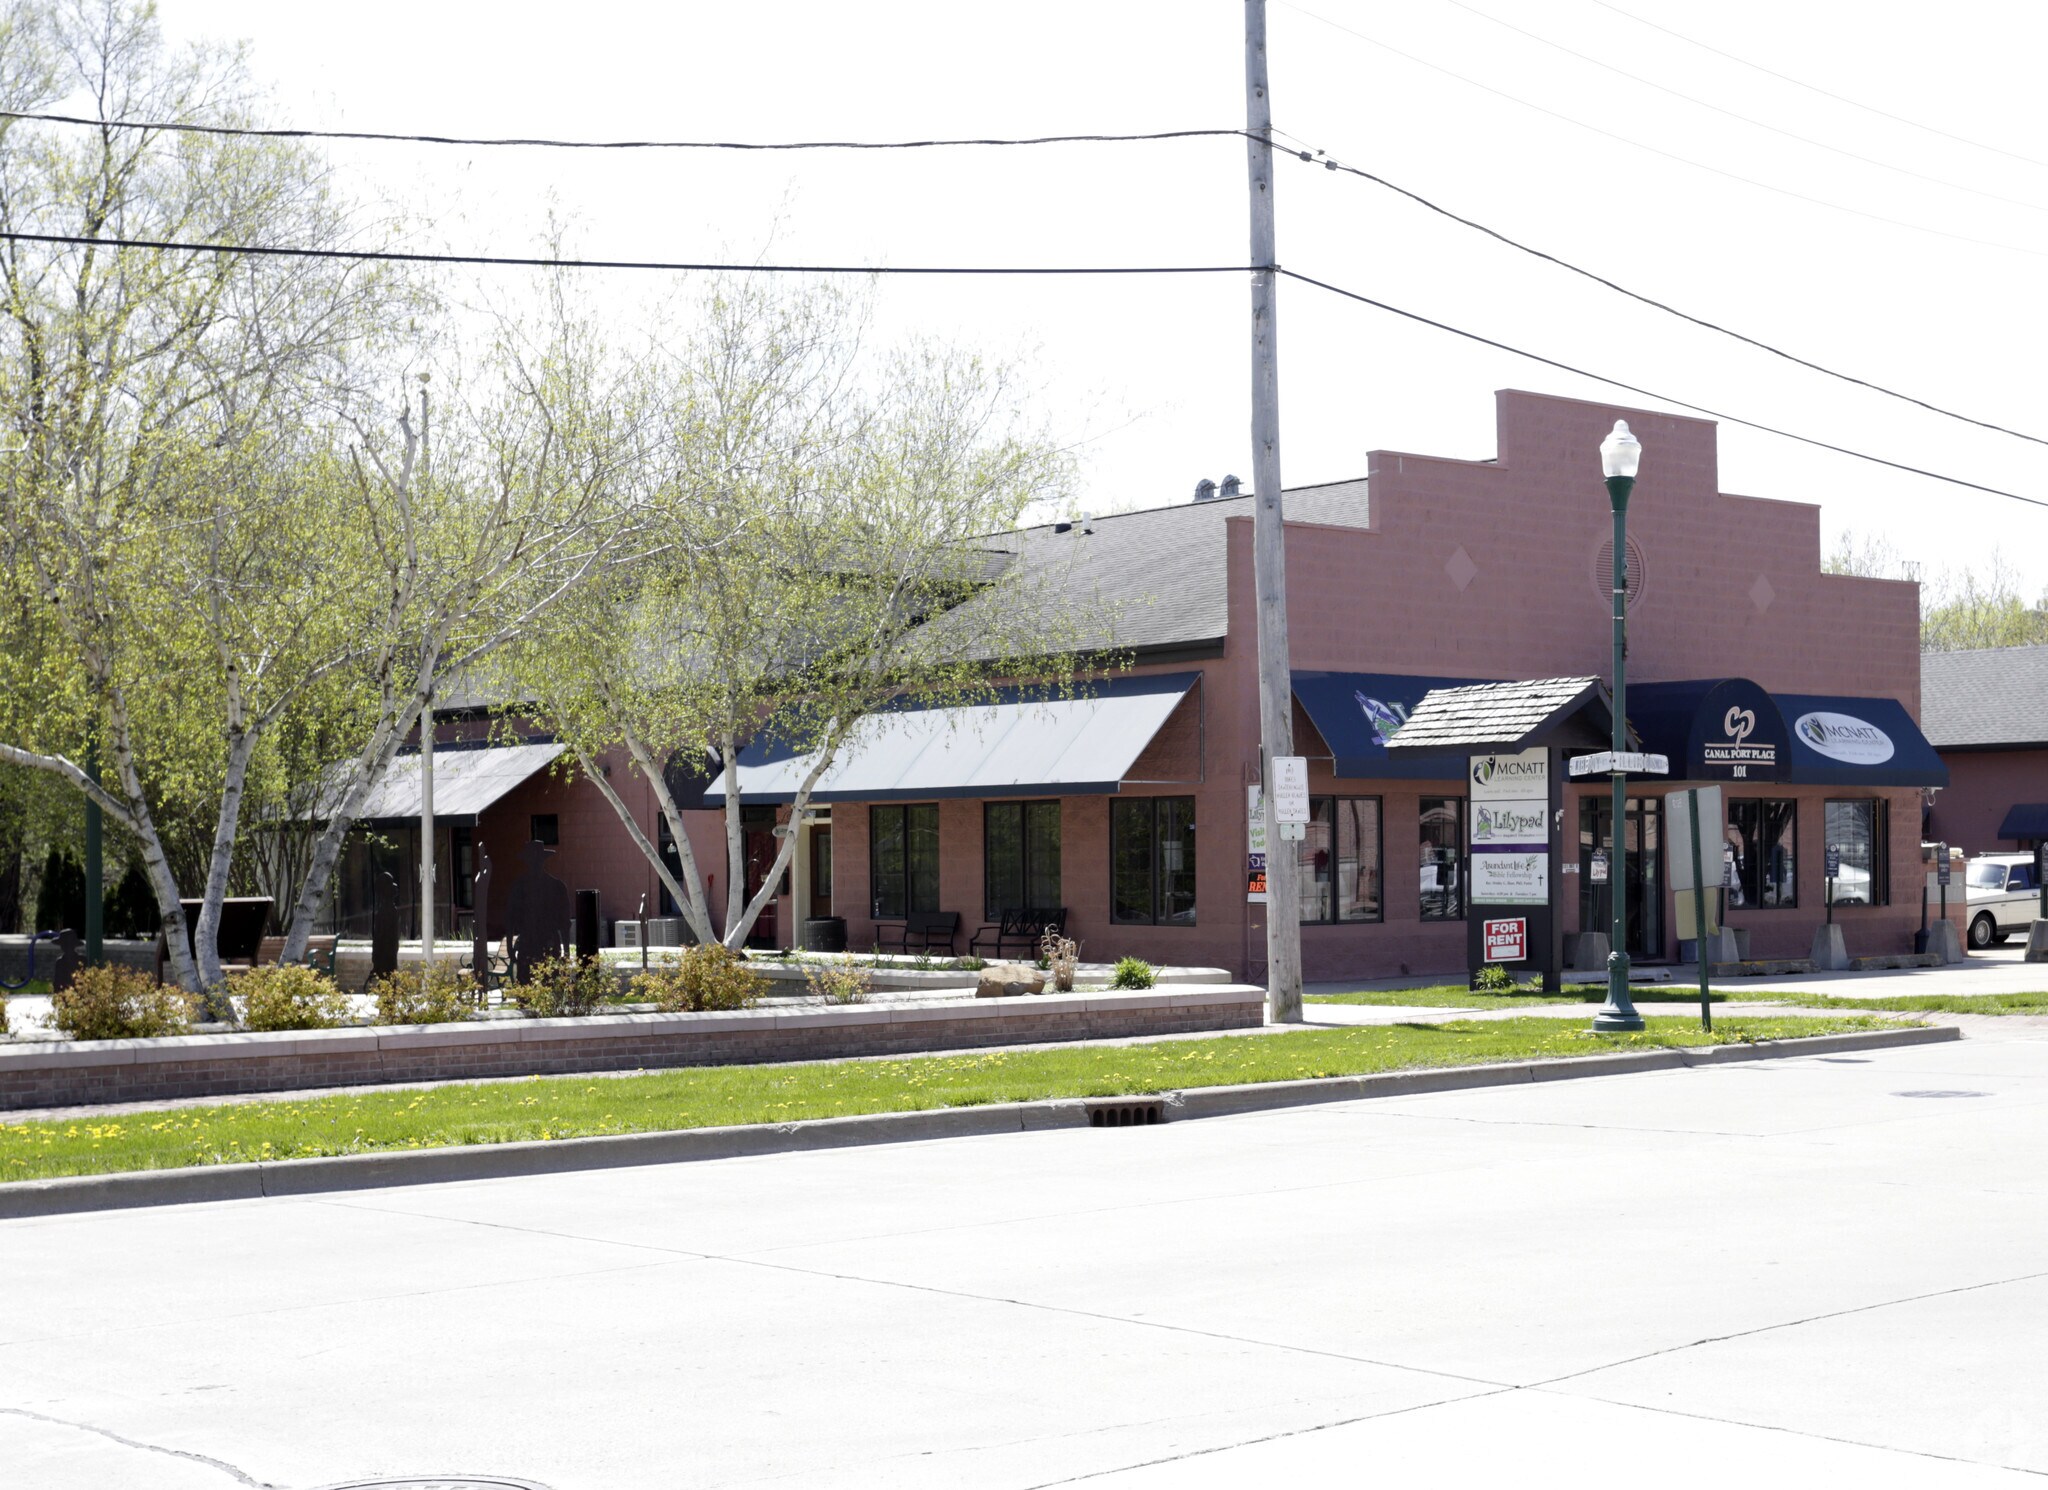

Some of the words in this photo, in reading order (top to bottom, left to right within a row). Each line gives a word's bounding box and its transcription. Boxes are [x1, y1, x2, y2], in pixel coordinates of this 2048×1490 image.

[1824, 724, 1879, 740] MCNATT
[1705, 749, 1730, 758] CANAL
[1731, 749, 1751, 759] PORT
[1752, 750, 1775, 760] PLACE
[1497, 761, 1545, 775] MCNATT
[1733, 765, 1747, 777] 101
[1493, 811, 1544, 833] Lilypad
[1252, 838, 1265, 849] Tod
[1249, 881, 1266, 892] REN
[1491, 922, 1519, 934] FOR
[1487, 933, 1523, 946] RENT
